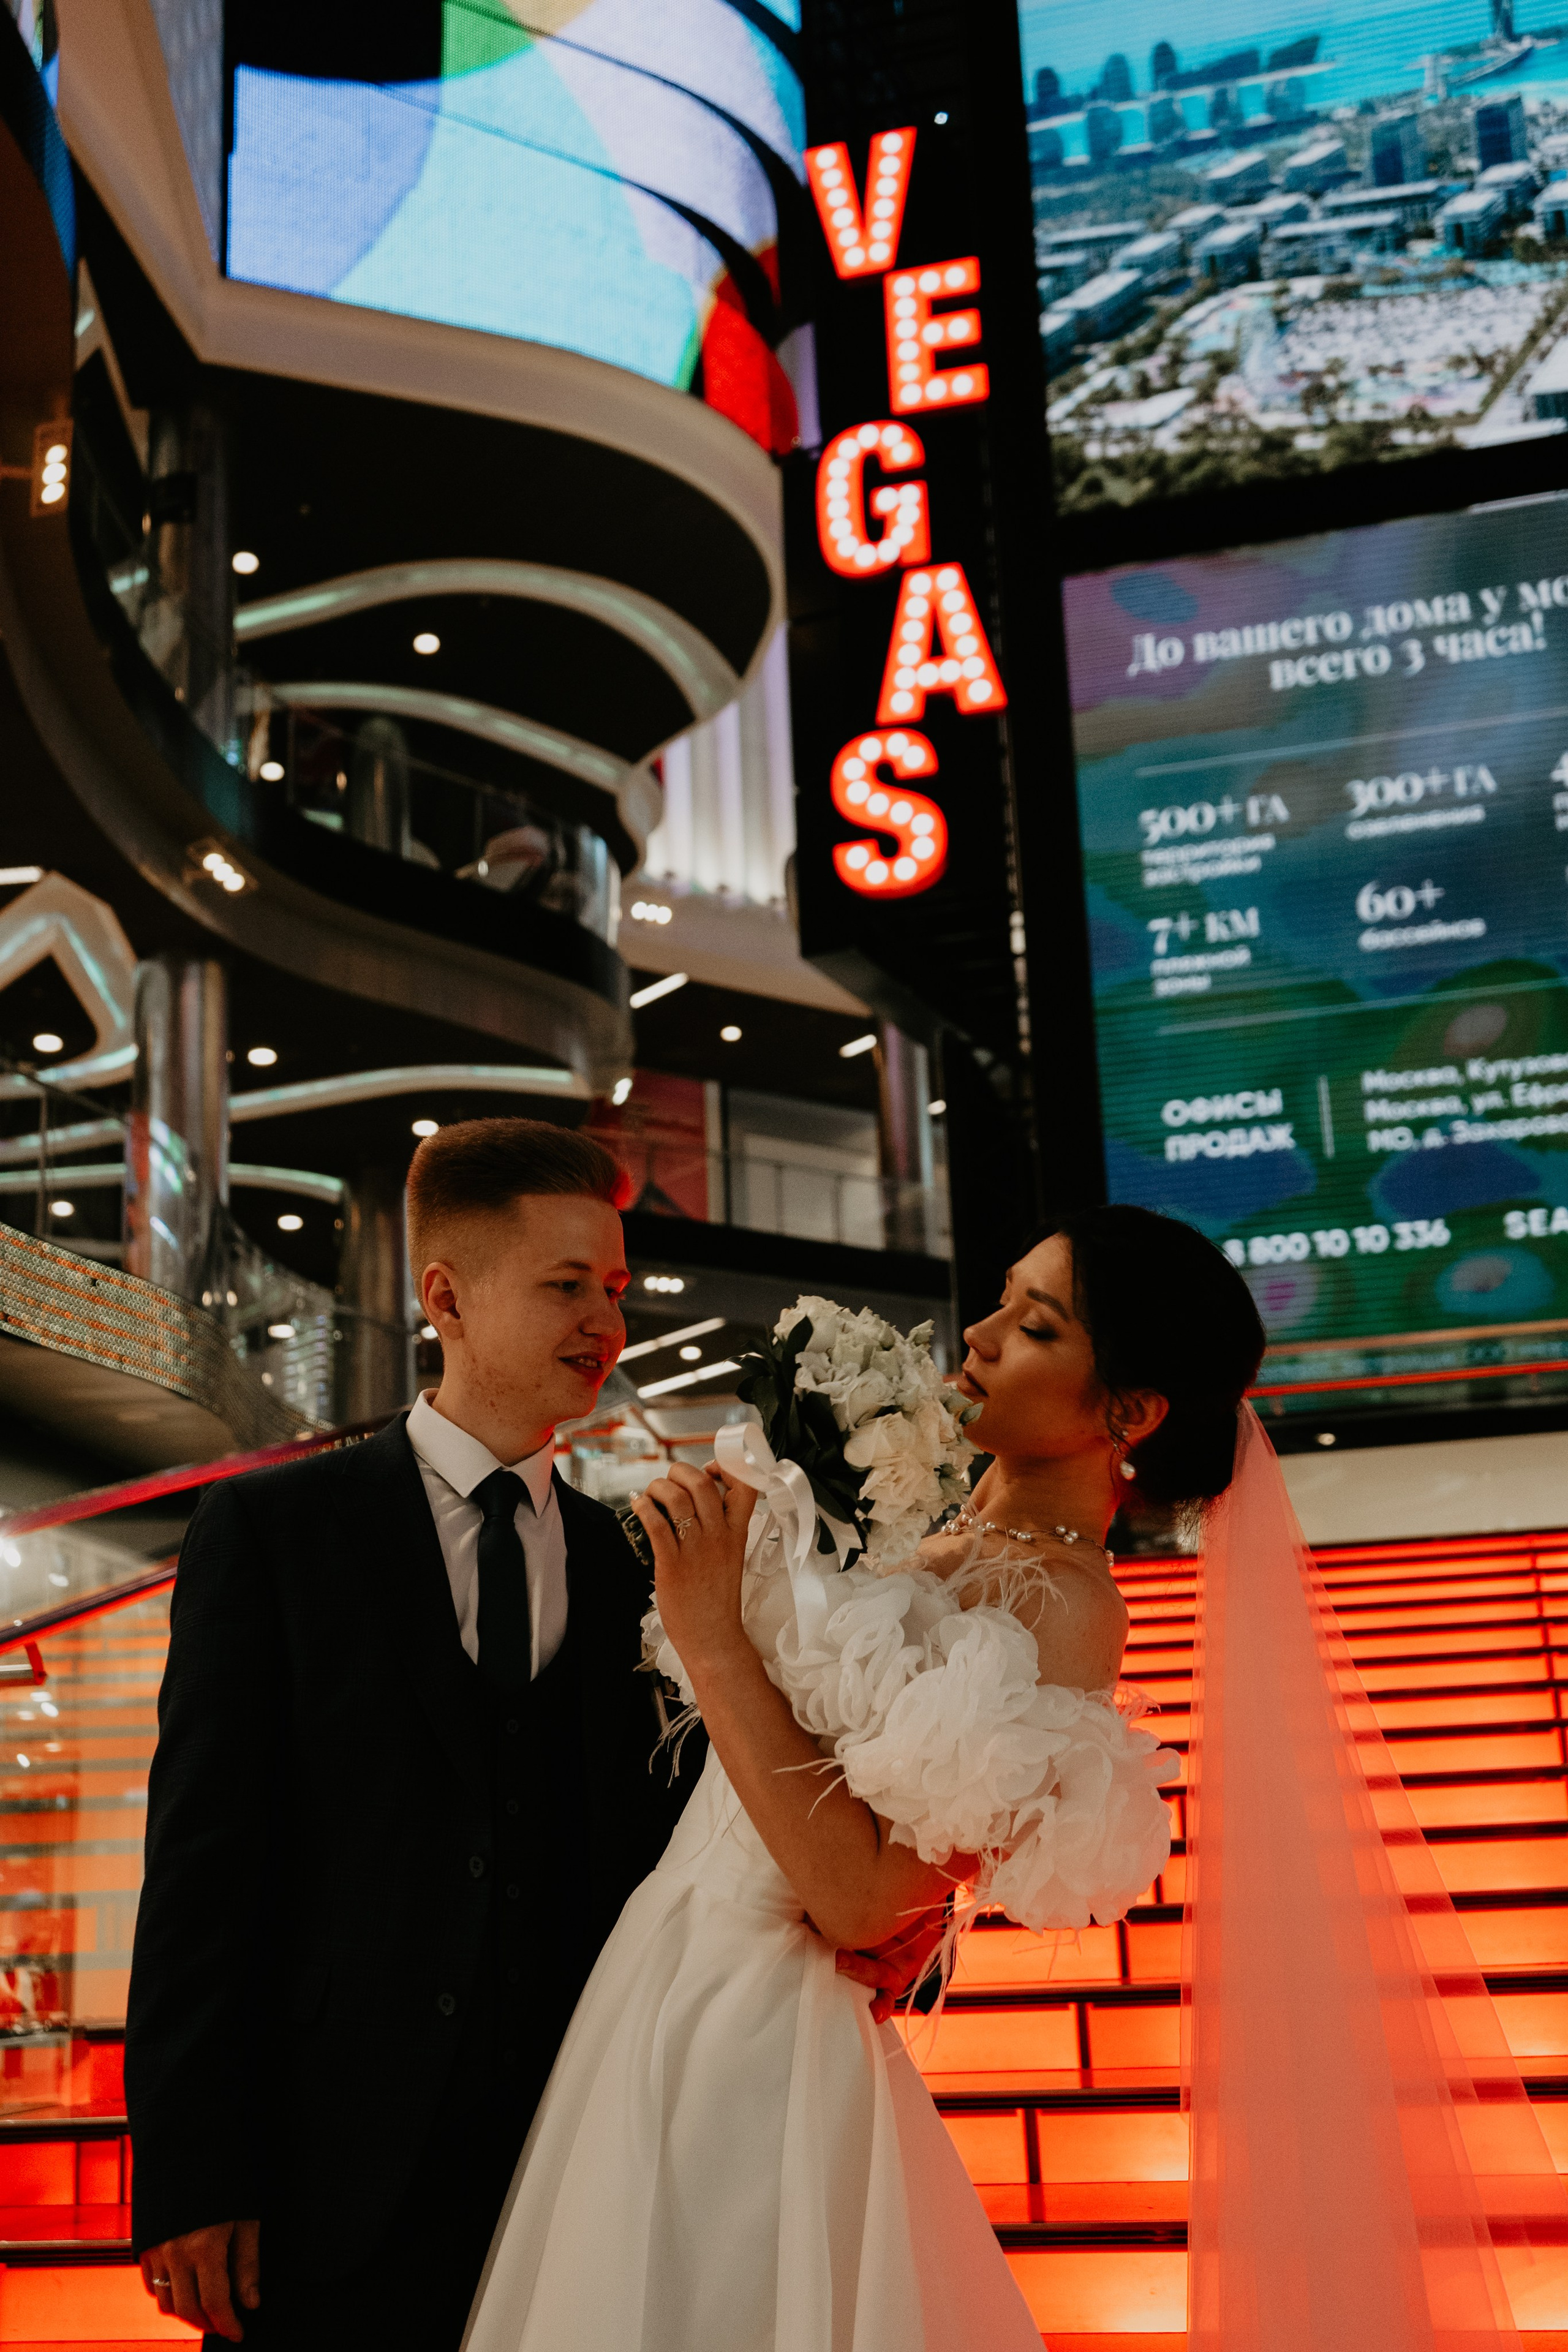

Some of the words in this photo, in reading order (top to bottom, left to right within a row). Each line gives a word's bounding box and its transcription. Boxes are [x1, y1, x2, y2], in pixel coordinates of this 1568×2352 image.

[804, 126, 1007, 898] VEGAS
[1127, 633, 1185, 677] До
[1194, 611, 1352, 662] вашего
[1359, 592, 1471, 641] дома
[1271, 646, 1390, 690] всего
[1401, 639, 1425, 676] 3
[1433, 611, 1546, 663] часа!
[1346, 767, 1450, 817] 300+
[1140, 796, 1242, 845] 500+
[1355, 880, 1445, 923] 60+
[1147, 911, 1199, 955] 7+
[1205, 907, 1259, 943] КМ
[1161, 1088, 1282, 1126] ОФИСЫ
[1166, 1123, 1295, 1162] ПРОДАЖ
[1248, 1232, 1310, 1264] 800
[1312, 1229, 1349, 1257] 10
[1352, 1225, 1390, 1254] 10
[1393, 1219, 1450, 1251] 336
